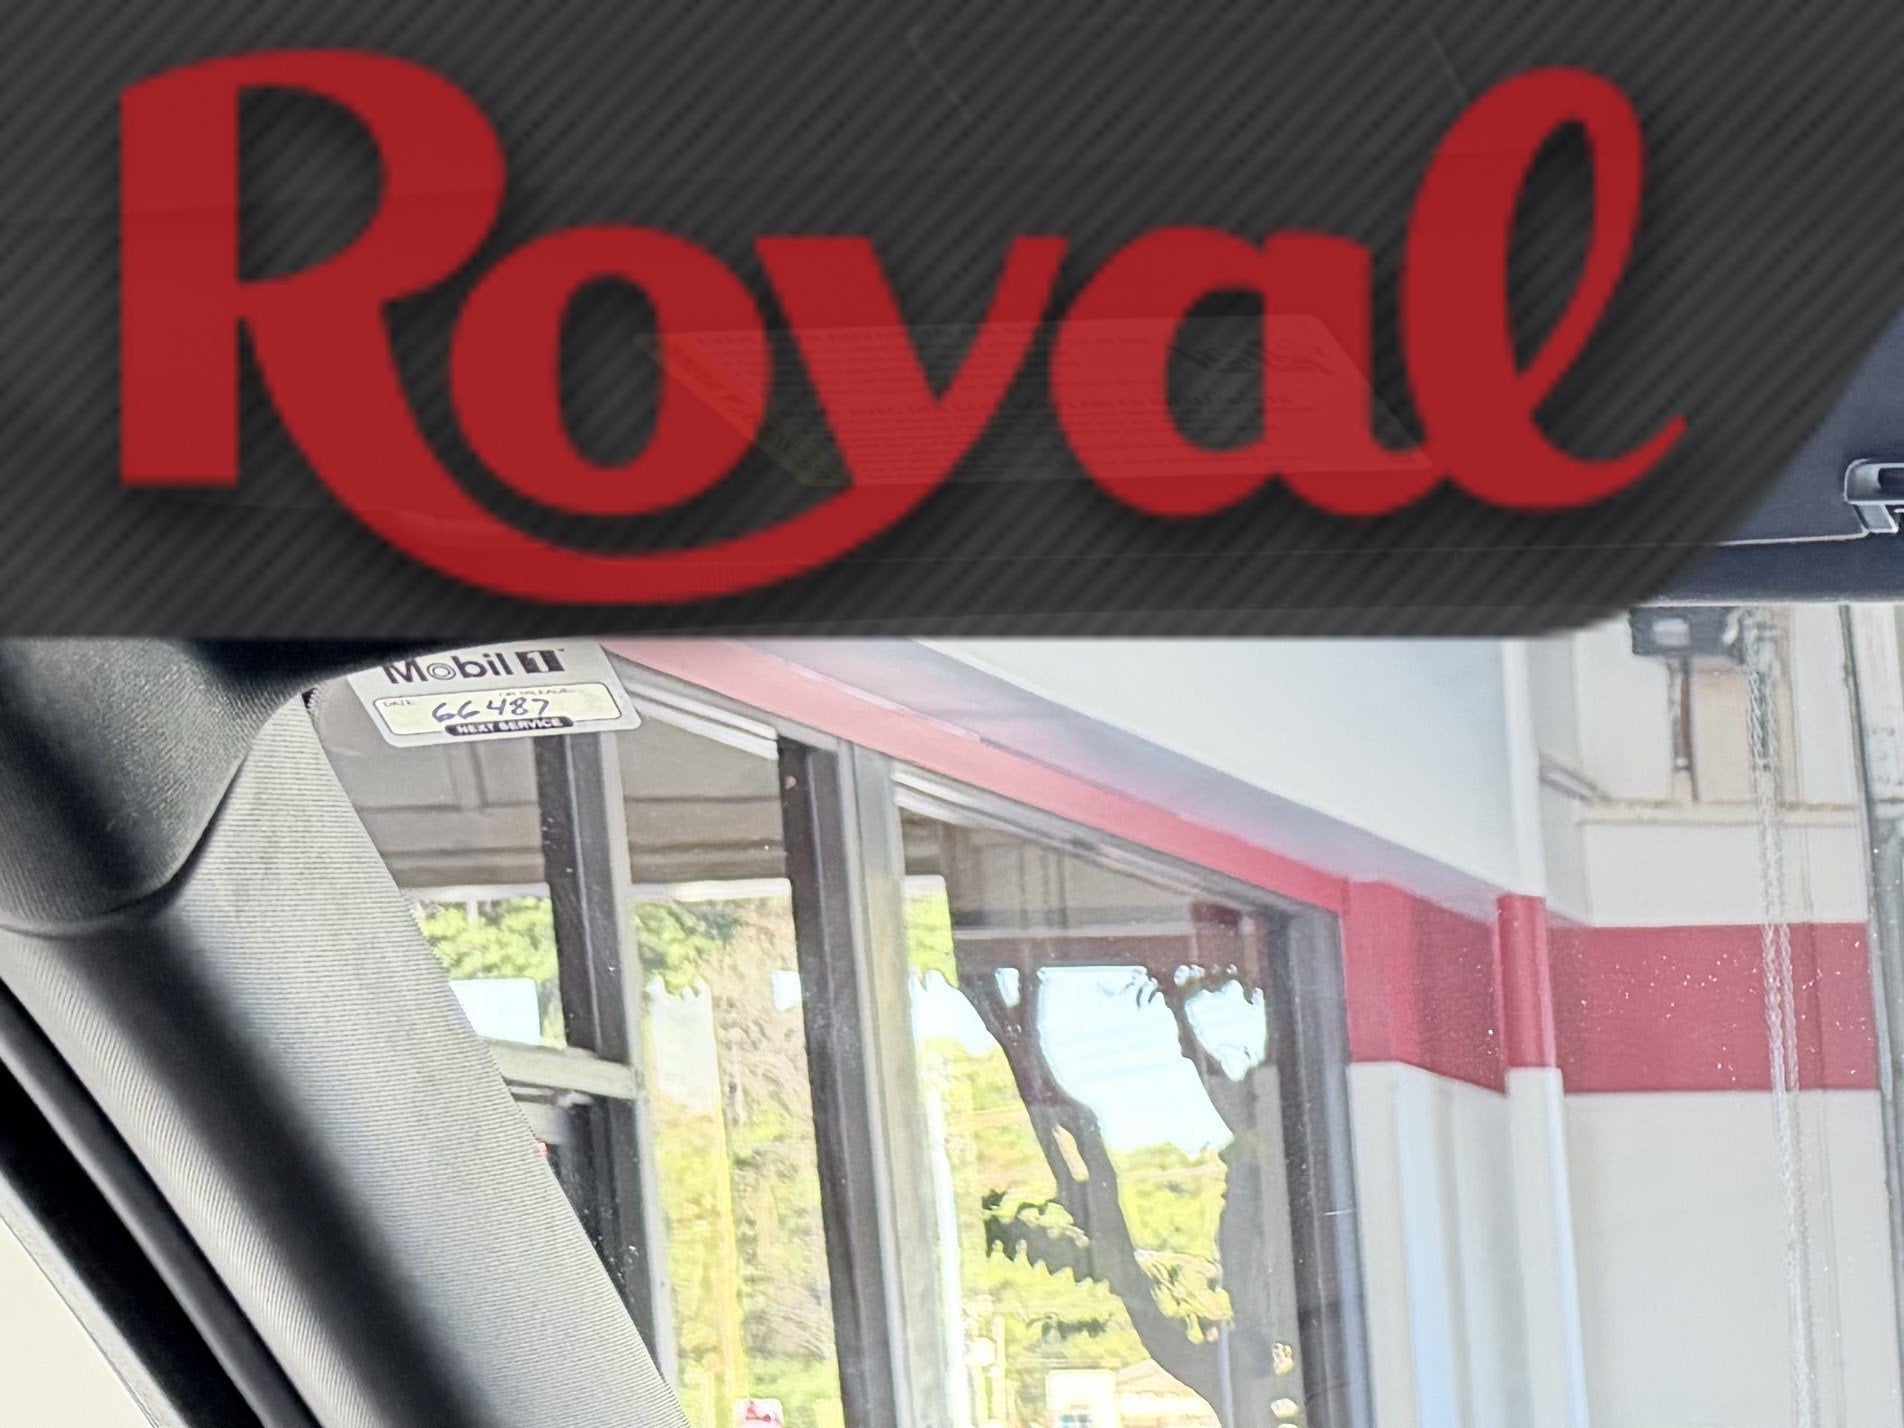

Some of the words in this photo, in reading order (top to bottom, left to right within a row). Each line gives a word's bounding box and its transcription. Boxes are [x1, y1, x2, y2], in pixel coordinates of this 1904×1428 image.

[382, 652, 514, 685] Mobil
[456, 722, 498, 736] NEXT
[499, 718, 562, 734] SERVICE
